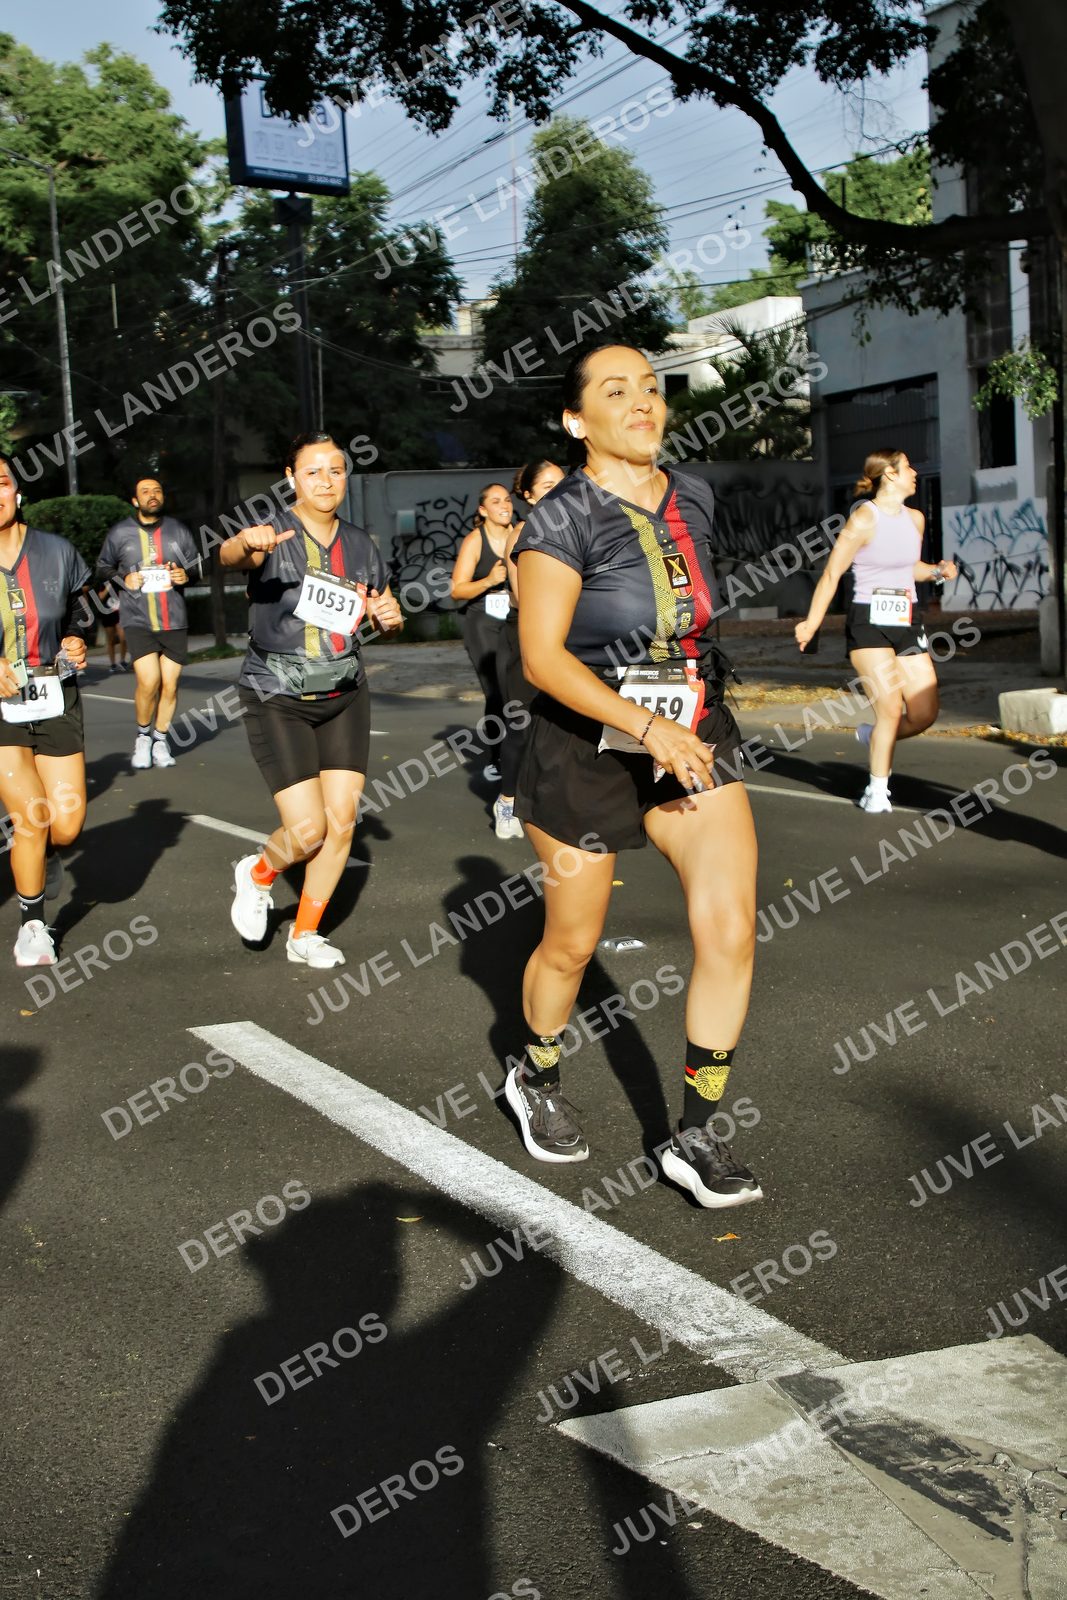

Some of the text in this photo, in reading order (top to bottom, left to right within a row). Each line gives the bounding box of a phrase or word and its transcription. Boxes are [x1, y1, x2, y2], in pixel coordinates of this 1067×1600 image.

[416, 494, 468, 515] TOY
[307, 584, 356, 616] 10531
[874, 600, 907, 612] 10763
